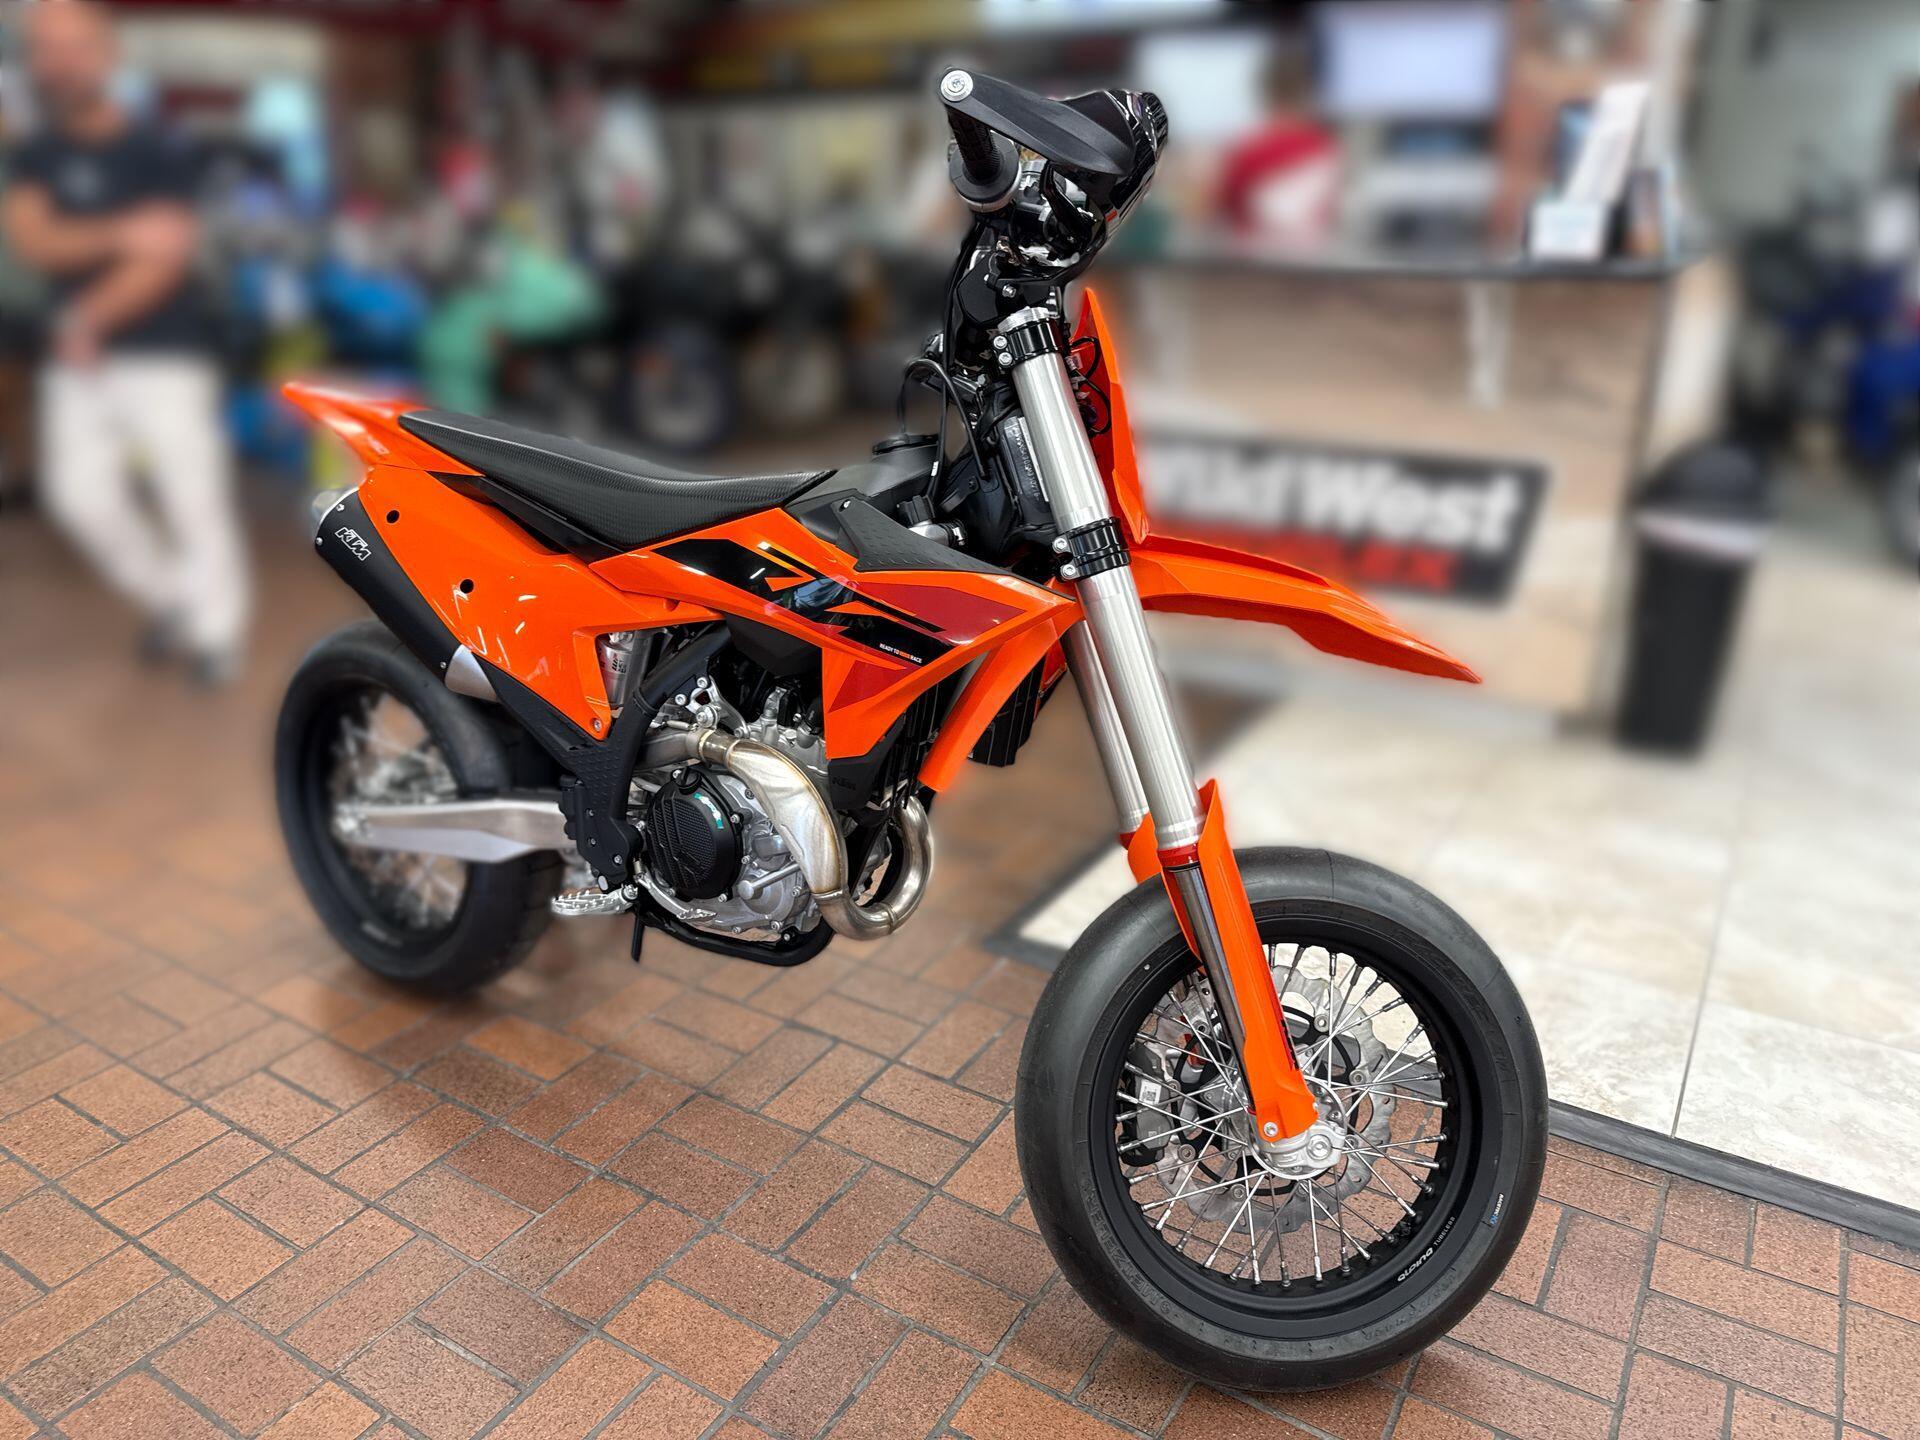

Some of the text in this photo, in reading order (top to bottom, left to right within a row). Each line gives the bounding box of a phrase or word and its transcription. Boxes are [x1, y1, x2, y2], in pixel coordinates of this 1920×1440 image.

[1303, 459, 1522, 552] West
[334, 526, 372, 561] KTM
[879, 642, 894, 652] READY
[910, 654, 922, 663] RACE
